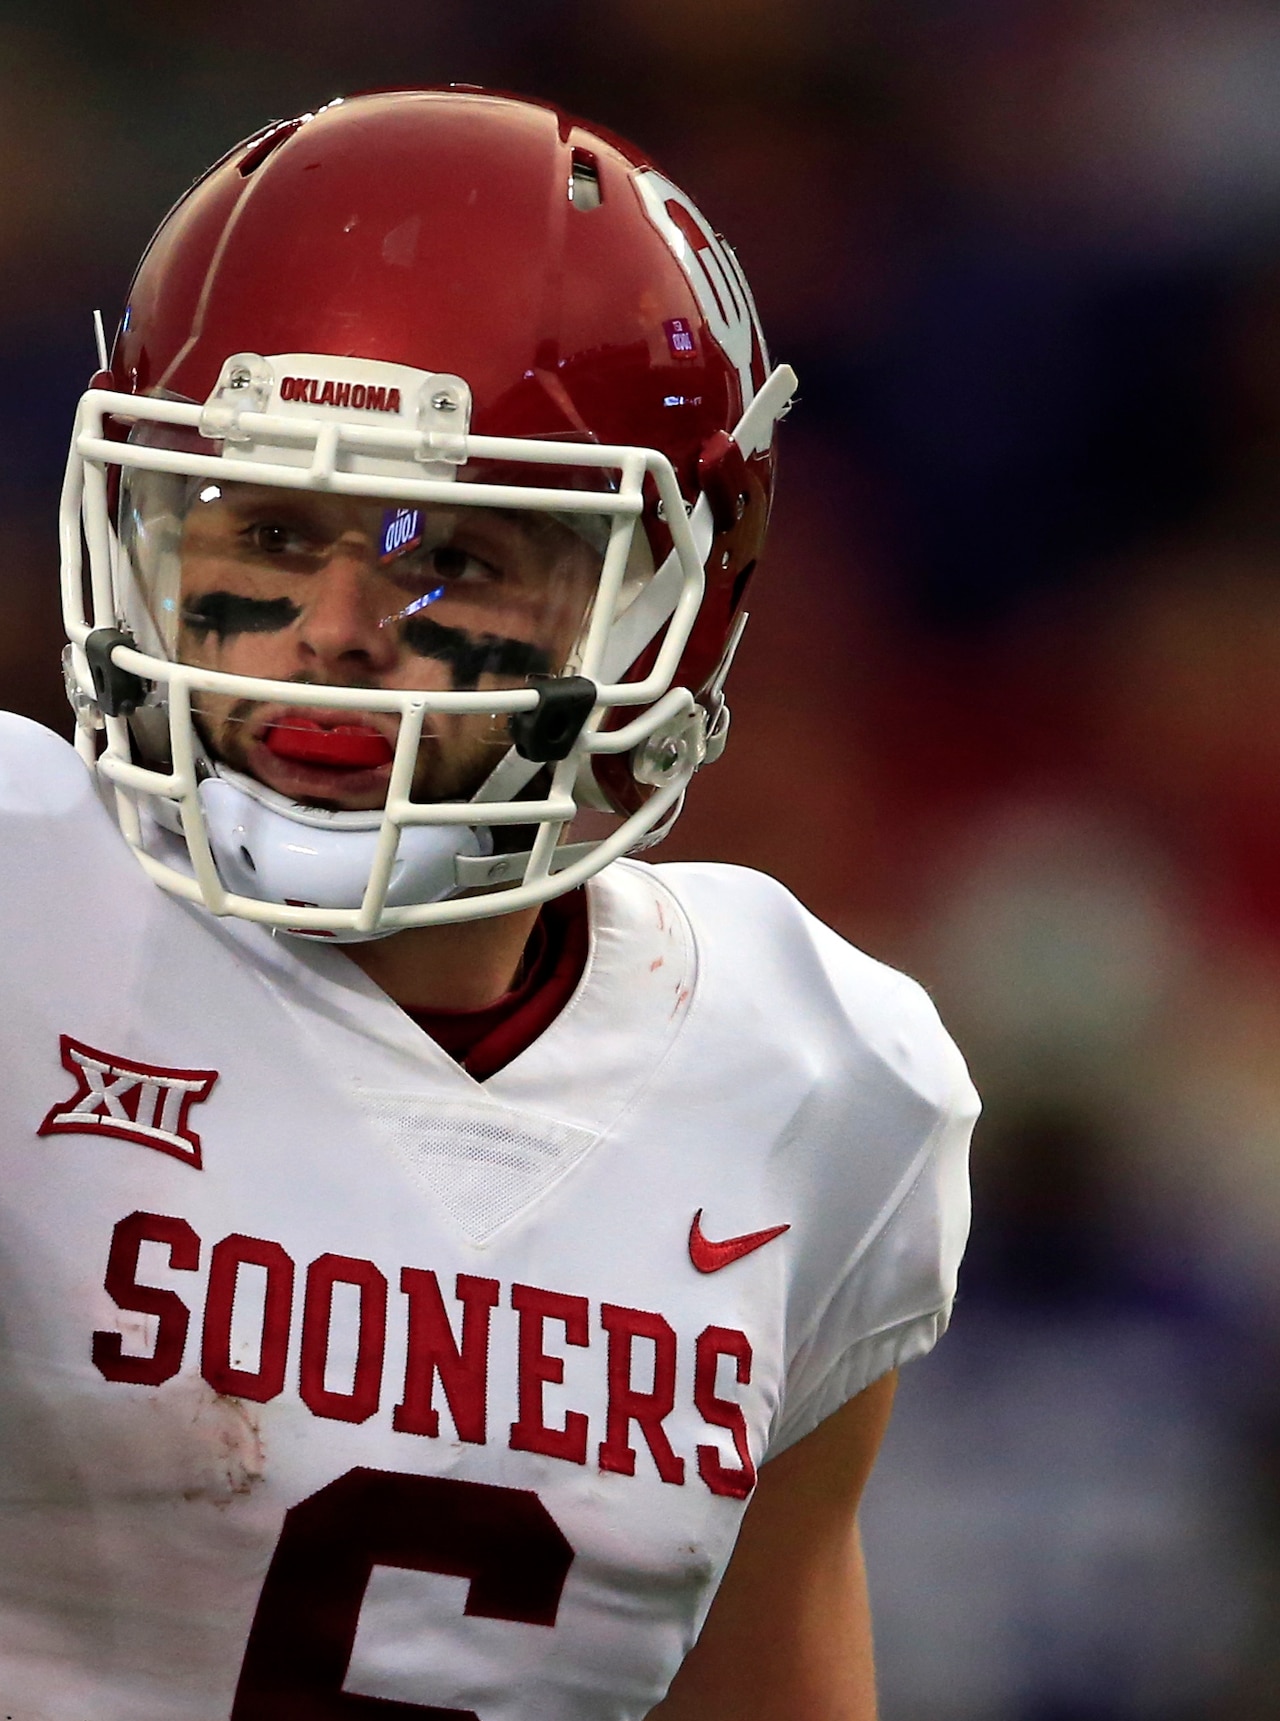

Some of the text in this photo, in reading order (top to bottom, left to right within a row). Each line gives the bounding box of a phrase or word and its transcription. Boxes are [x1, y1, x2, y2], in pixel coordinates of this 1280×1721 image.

[280, 376, 401, 413] OKLAHOMA
[52, 1048, 208, 1155] XII
[92, 1211, 756, 1500] SOONERS
